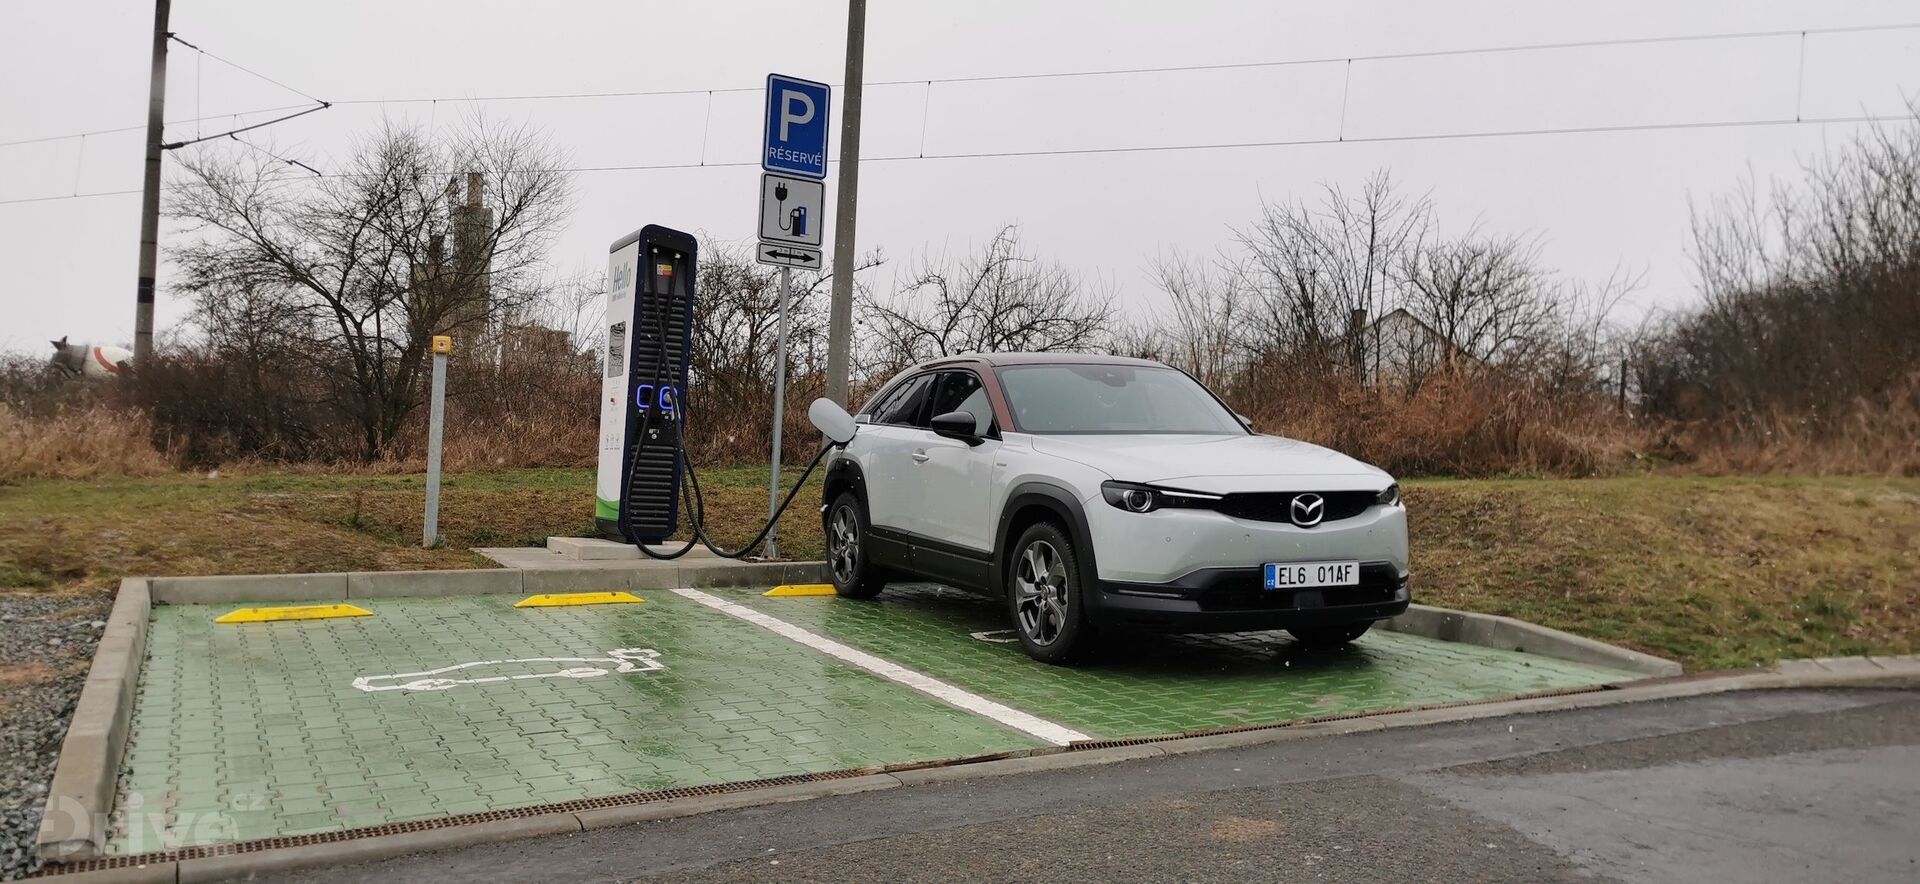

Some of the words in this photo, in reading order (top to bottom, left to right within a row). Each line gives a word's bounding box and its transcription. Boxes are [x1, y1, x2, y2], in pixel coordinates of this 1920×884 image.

[779, 89, 815, 142] P
[768, 146, 822, 166] RÉSERVÉ
[612, 261, 632, 293] Hello
[1279, 567, 1306, 585] EL6
[1318, 564, 1352, 583] 01AF
